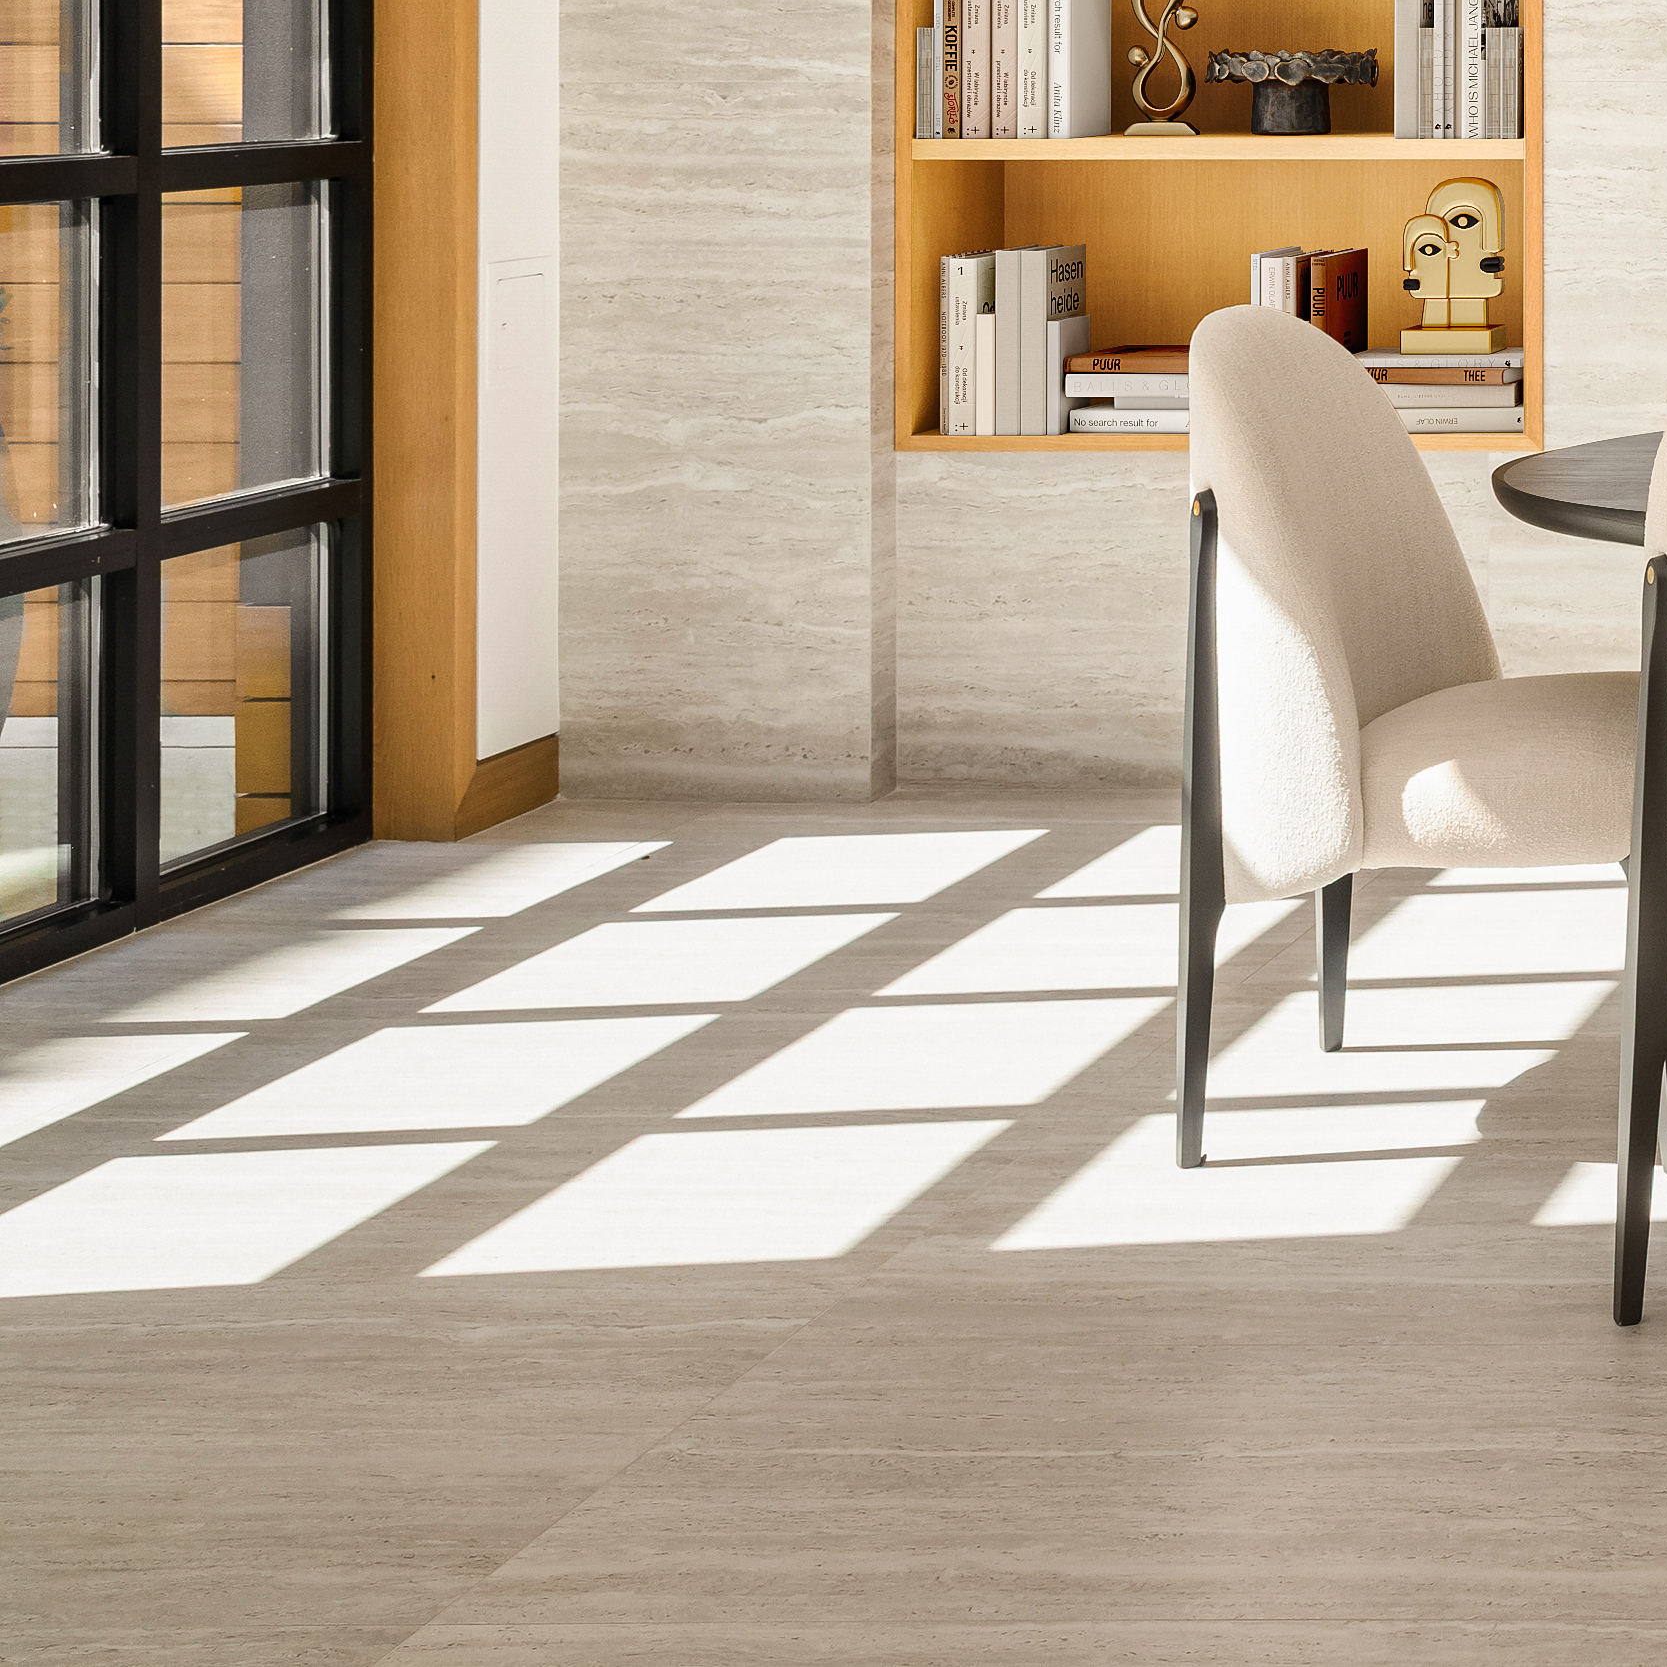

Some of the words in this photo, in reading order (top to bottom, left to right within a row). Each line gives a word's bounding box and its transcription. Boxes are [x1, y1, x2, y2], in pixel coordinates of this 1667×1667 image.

[1054, 14, 1063, 39] result
[945, 25, 957, 71] KOFFIE
[1053, 41, 1063, 55] for
[1053, 81, 1063, 107] Anita
[1053, 109, 1063, 134] Klinz
[1051, 258, 1084, 285] Hasen
[1051, 290, 1080, 316] heide
[1312, 287, 1325, 318] PUUR
[1091, 358, 1121, 370] PUUR
[1463, 370, 1486, 381] THEE
[1073, 418, 1087, 427] No
[1088, 419, 1118, 427] search
[1119, 418, 1144, 427] result
[1146, 418, 1159, 428] for
